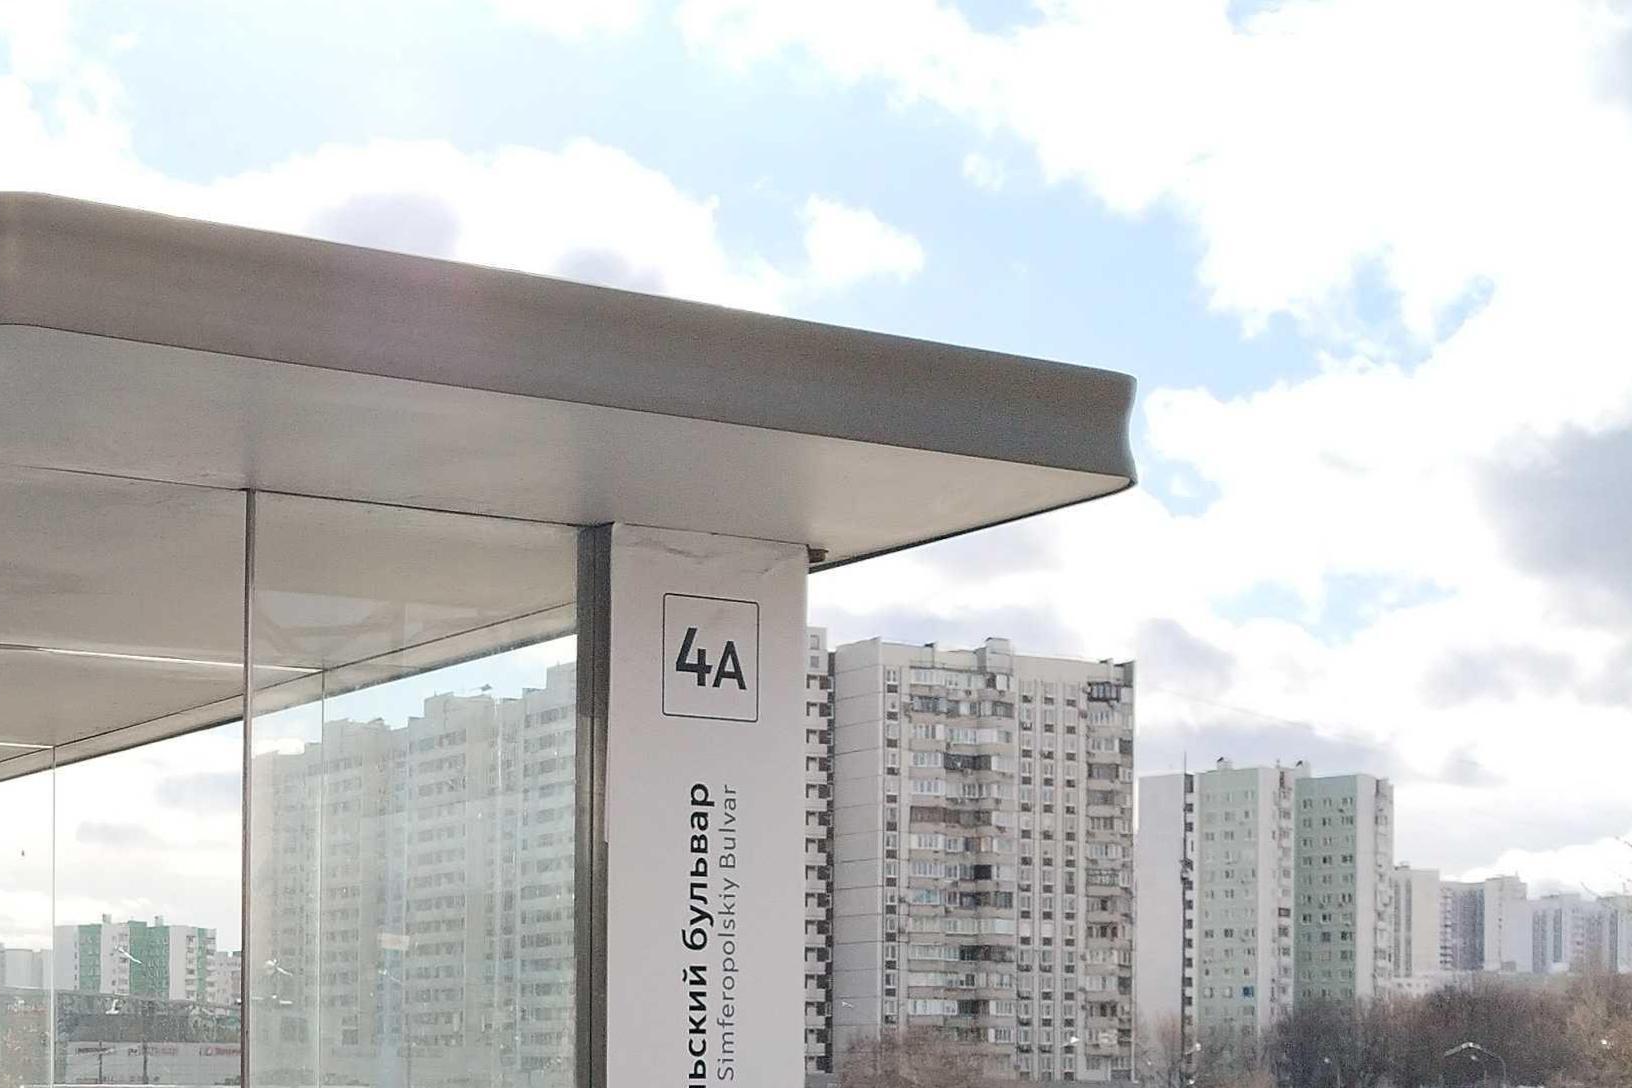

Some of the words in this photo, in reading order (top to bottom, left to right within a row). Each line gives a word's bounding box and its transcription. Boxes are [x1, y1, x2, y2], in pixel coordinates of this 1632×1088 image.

[681, 783, 715, 950] бульвар
[718, 785, 736, 868] Bulvar
[717, 878, 739, 1081] Simferopolskiy
